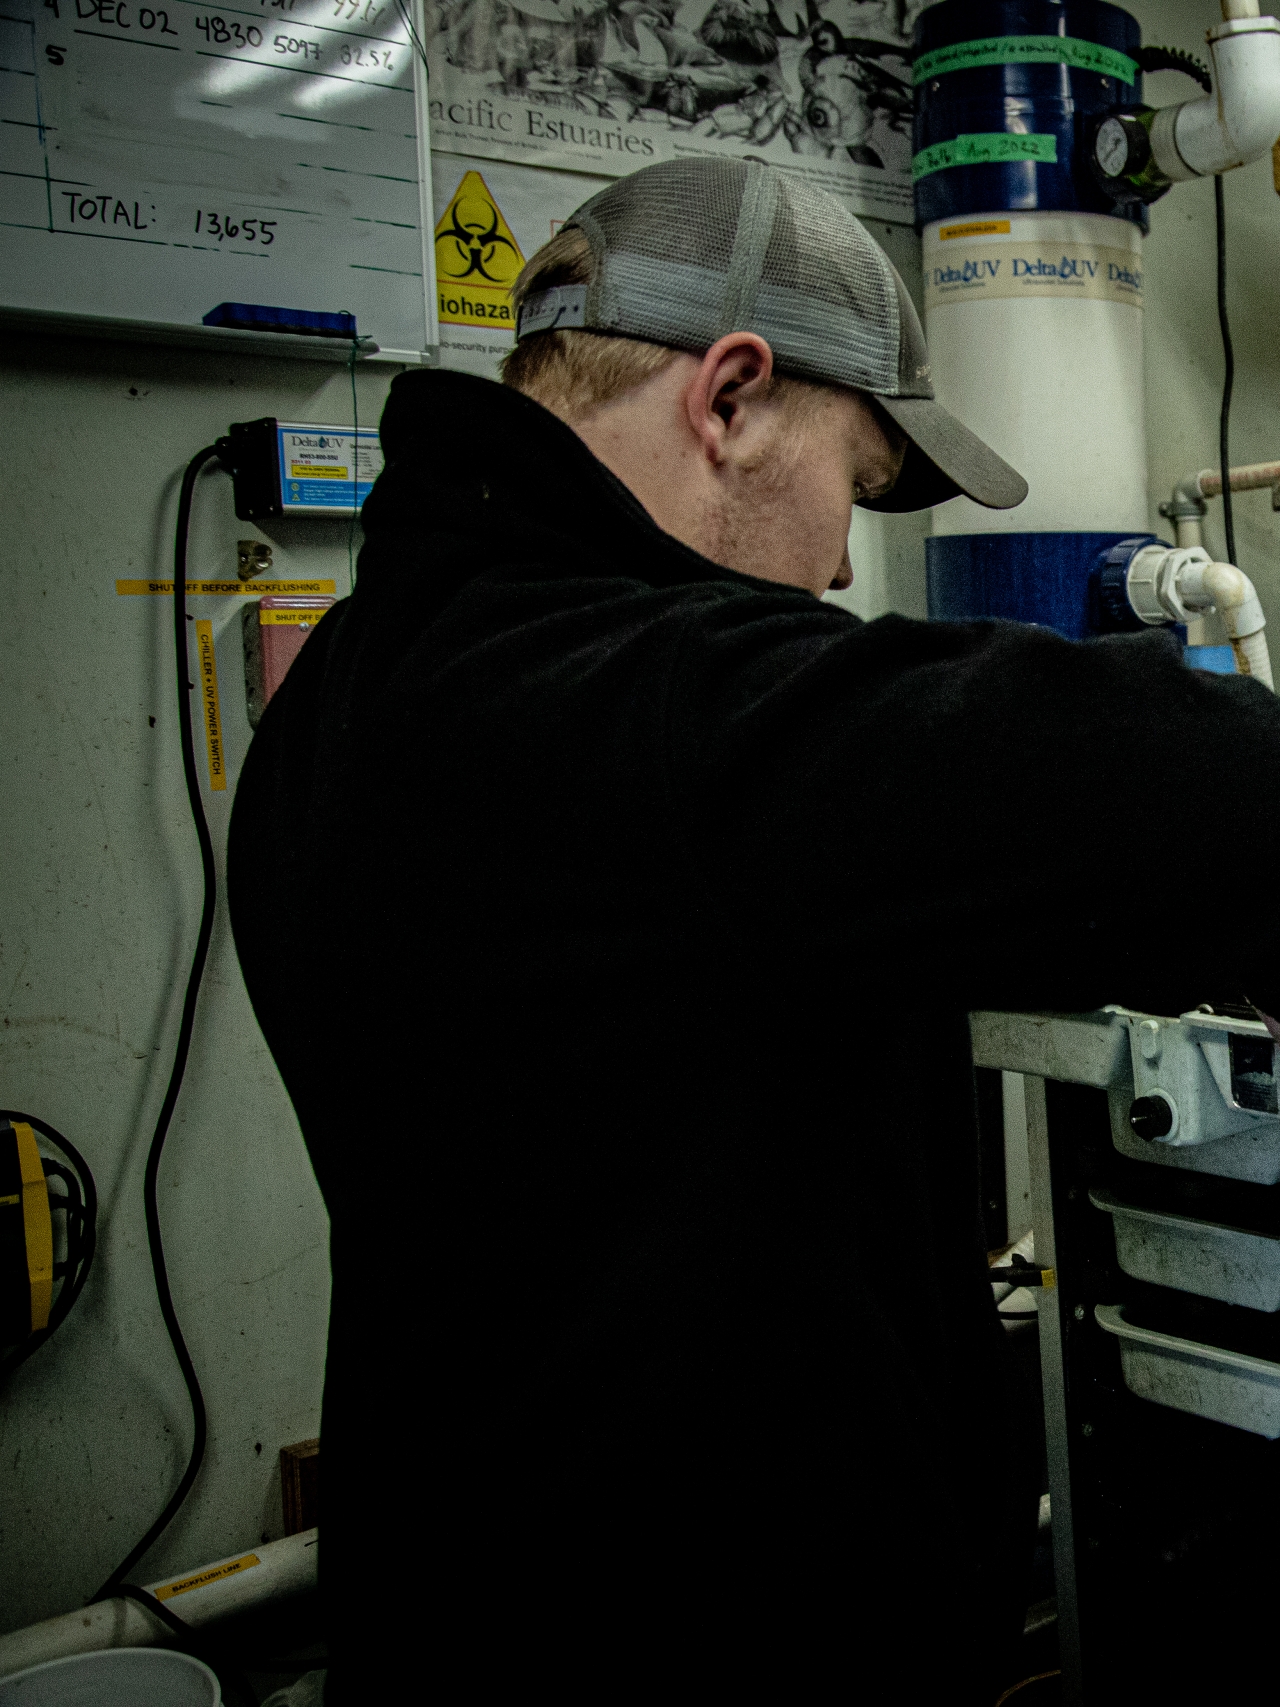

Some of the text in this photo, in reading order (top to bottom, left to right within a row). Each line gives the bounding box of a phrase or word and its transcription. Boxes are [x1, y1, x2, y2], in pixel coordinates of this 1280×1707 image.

[76, 0, 130, 28] DEC
[139, 9, 178, 35] 02
[195, 16, 263, 47] 4830
[45, 44, 67, 65] 5
[526, 109, 654, 156] Estuaries
[62, 192, 277, 245] TOTAL: 13,655
[933, 266, 962, 285] Delta
[1012, 258, 1098, 277] Delta UV
[440, 294, 514, 320] iohaza
[291, 435, 344, 448] Delta UV
[202, 584, 241, 592] BEFORE
[245, 584, 320, 592] BACKFLUSHING
[201, 634, 213, 675] CHILLER
[207, 686, 215, 699] UV
[208, 701, 218, 736] POWER
[210, 738, 222, 775] SWITCH
[172, 1563, 241, 1592] BACKFLUSH LINE
